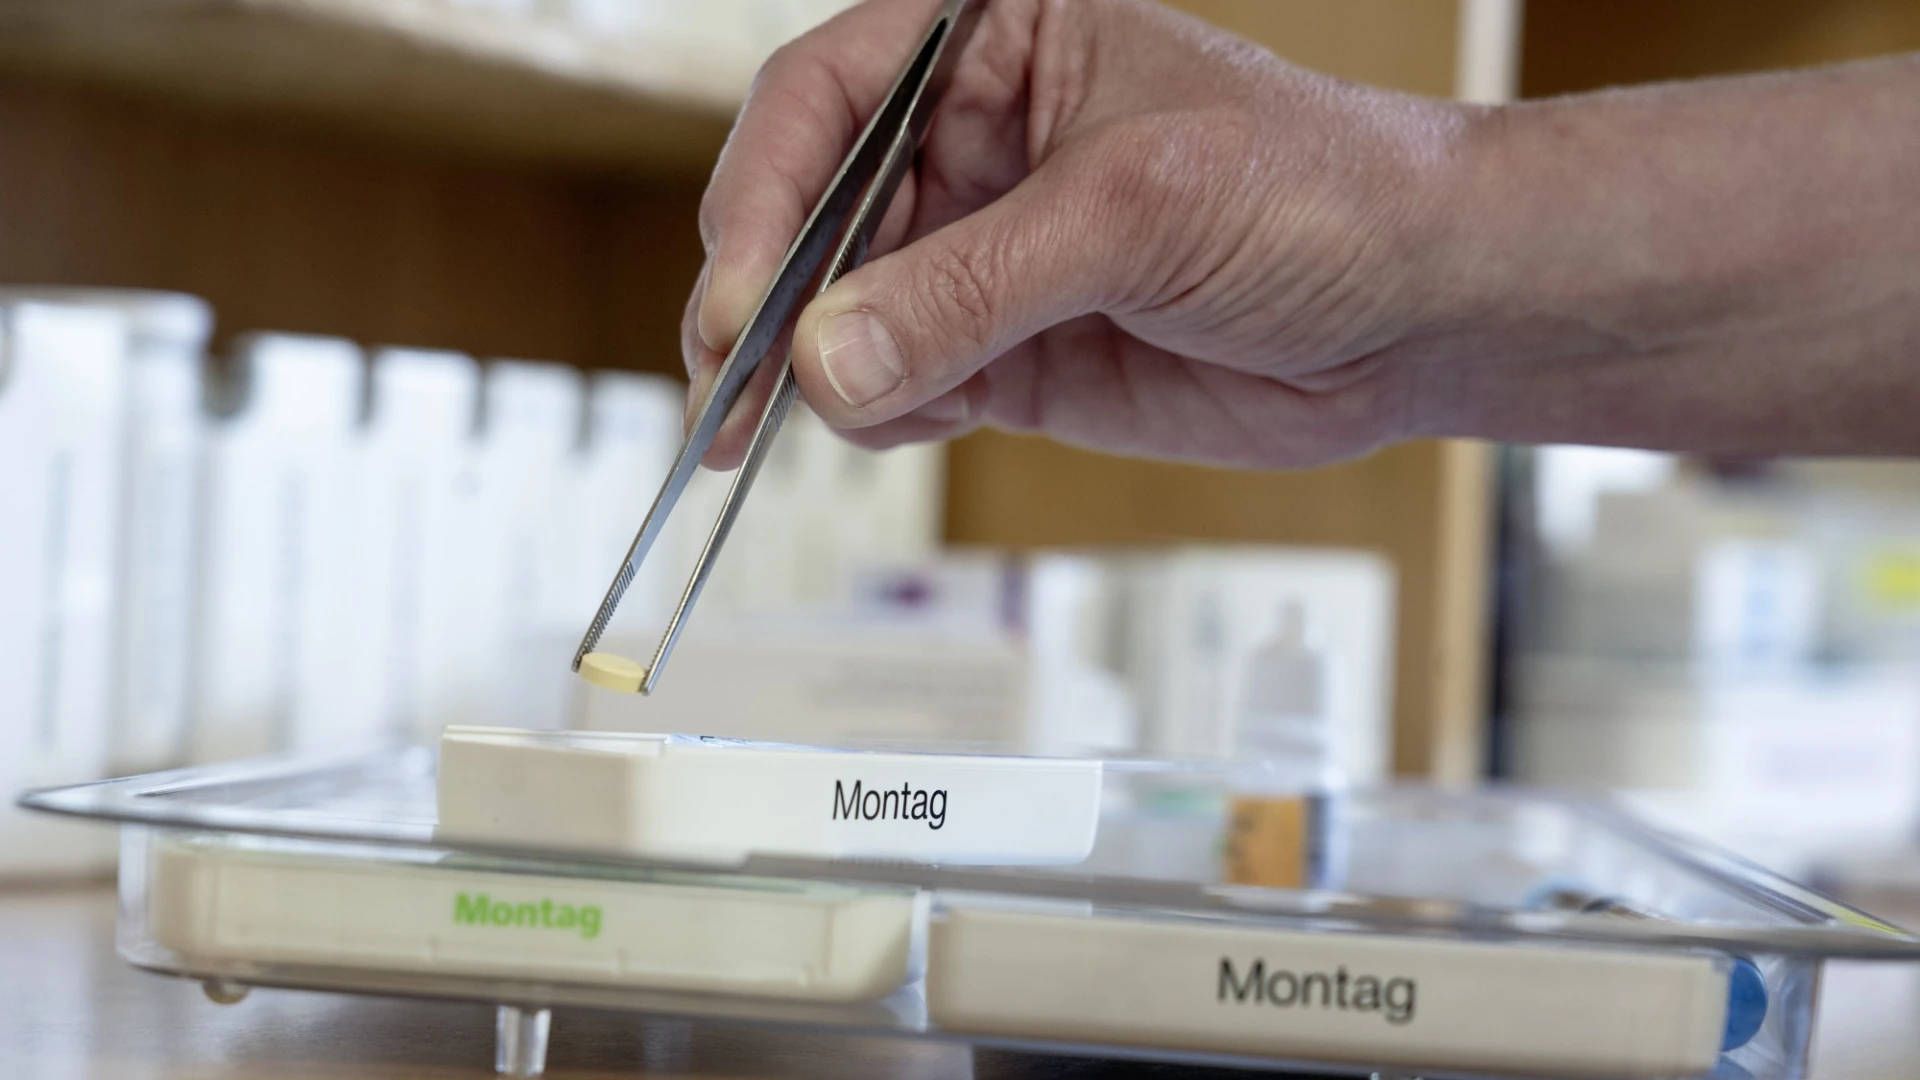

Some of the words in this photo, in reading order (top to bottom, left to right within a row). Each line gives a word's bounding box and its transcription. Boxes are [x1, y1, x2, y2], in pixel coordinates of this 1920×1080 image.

[832, 780, 948, 830] Montag
[453, 892, 603, 940] Montag
[1217, 957, 1417, 1024] Montag
